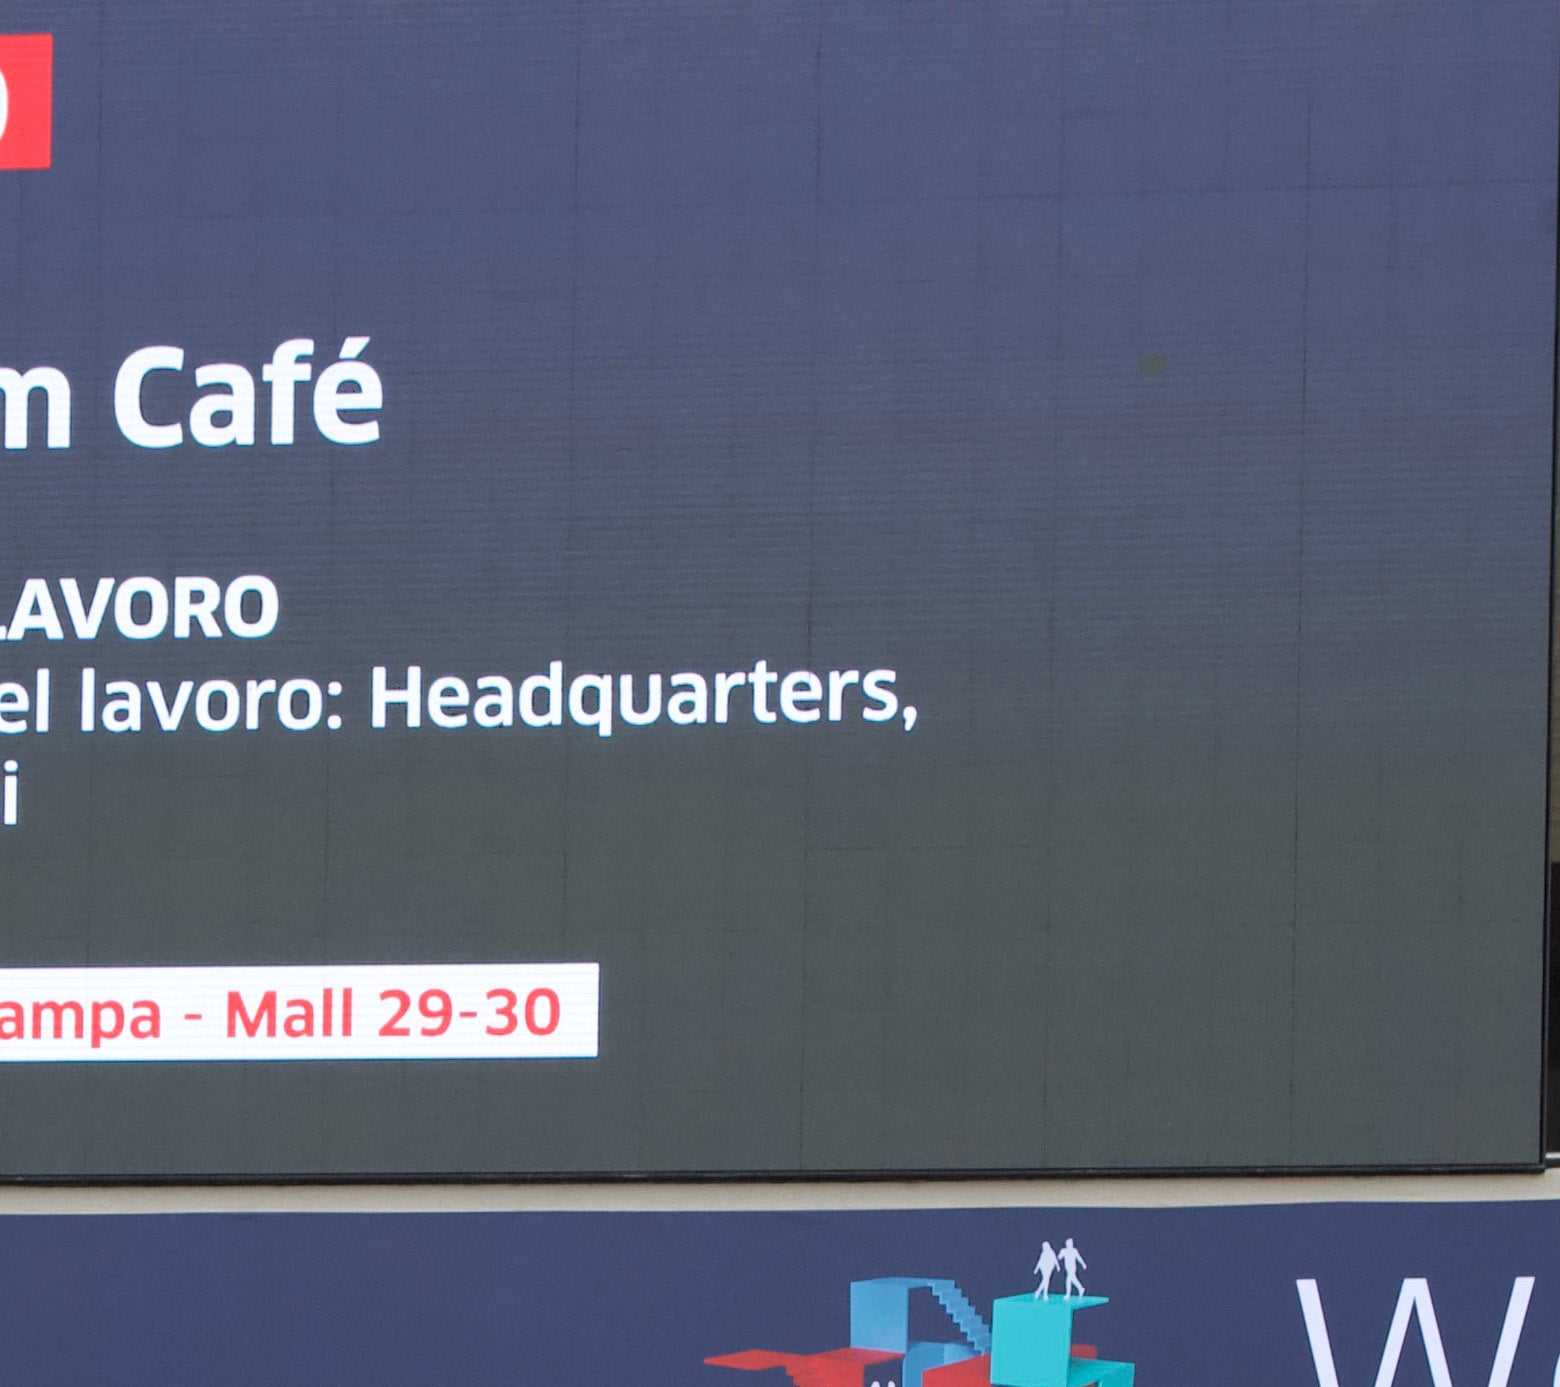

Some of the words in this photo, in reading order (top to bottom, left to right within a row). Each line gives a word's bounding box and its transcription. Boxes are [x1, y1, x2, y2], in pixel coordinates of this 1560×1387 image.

[114, 337, 382, 447] Café
[82, 668, 342, 732] lavoro:
[372, 660, 917, 736] Headquarters,
[228, 989, 352, 1037] Mall
[379, 988, 559, 1036] 29-30
